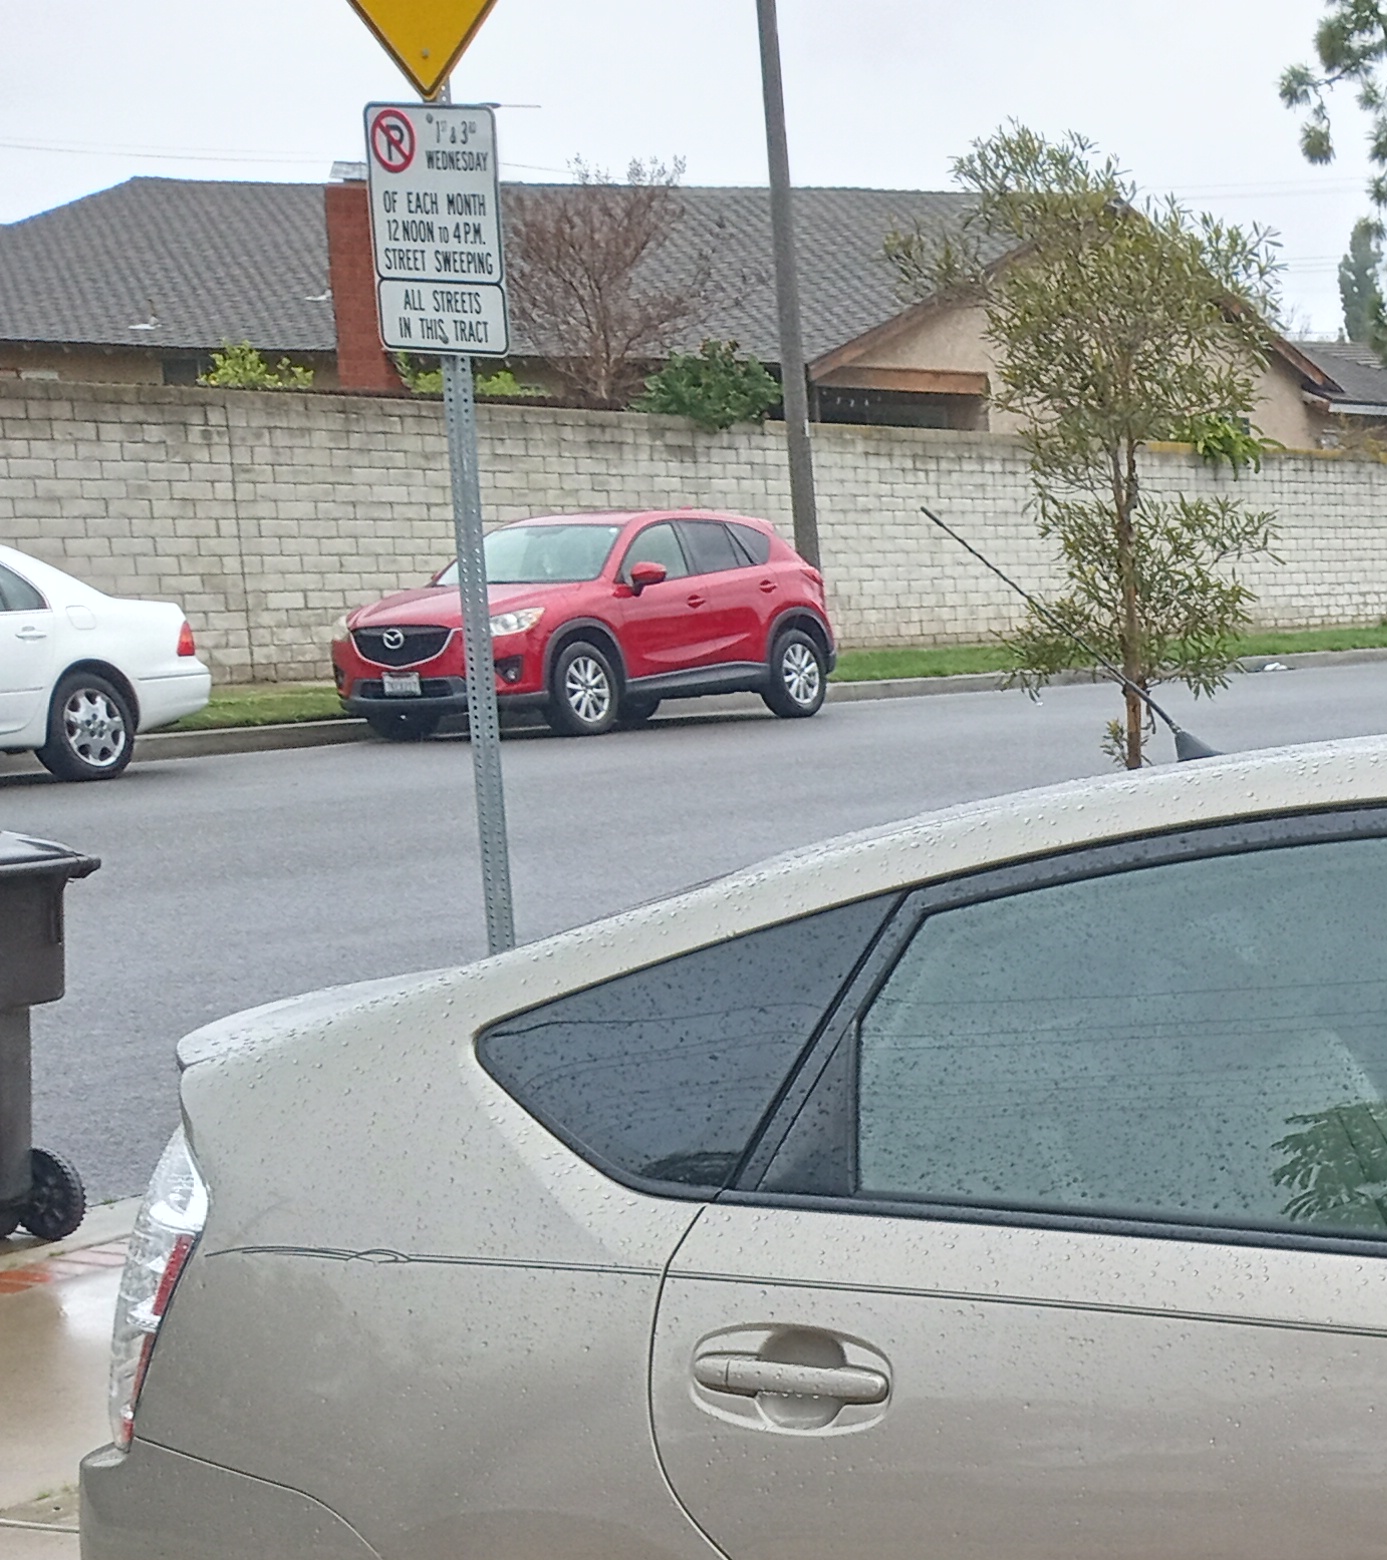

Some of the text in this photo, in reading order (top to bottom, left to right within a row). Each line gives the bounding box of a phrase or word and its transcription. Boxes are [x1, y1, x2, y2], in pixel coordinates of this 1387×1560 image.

[425, 150, 489, 171] WEDNESDAY
[383, 190, 486, 216] OF EACH MONTH
[386, 218, 400, 241] 12
[402, 219, 435, 242] NOON
[453, 221, 462, 245] 4
[463, 222, 486, 245] P.M.
[384, 247, 494, 275] STREET SWEEPING
[403, 288, 482, 314] ALL STREETS
[398, 316, 489, 344] IN THIS TRACT
